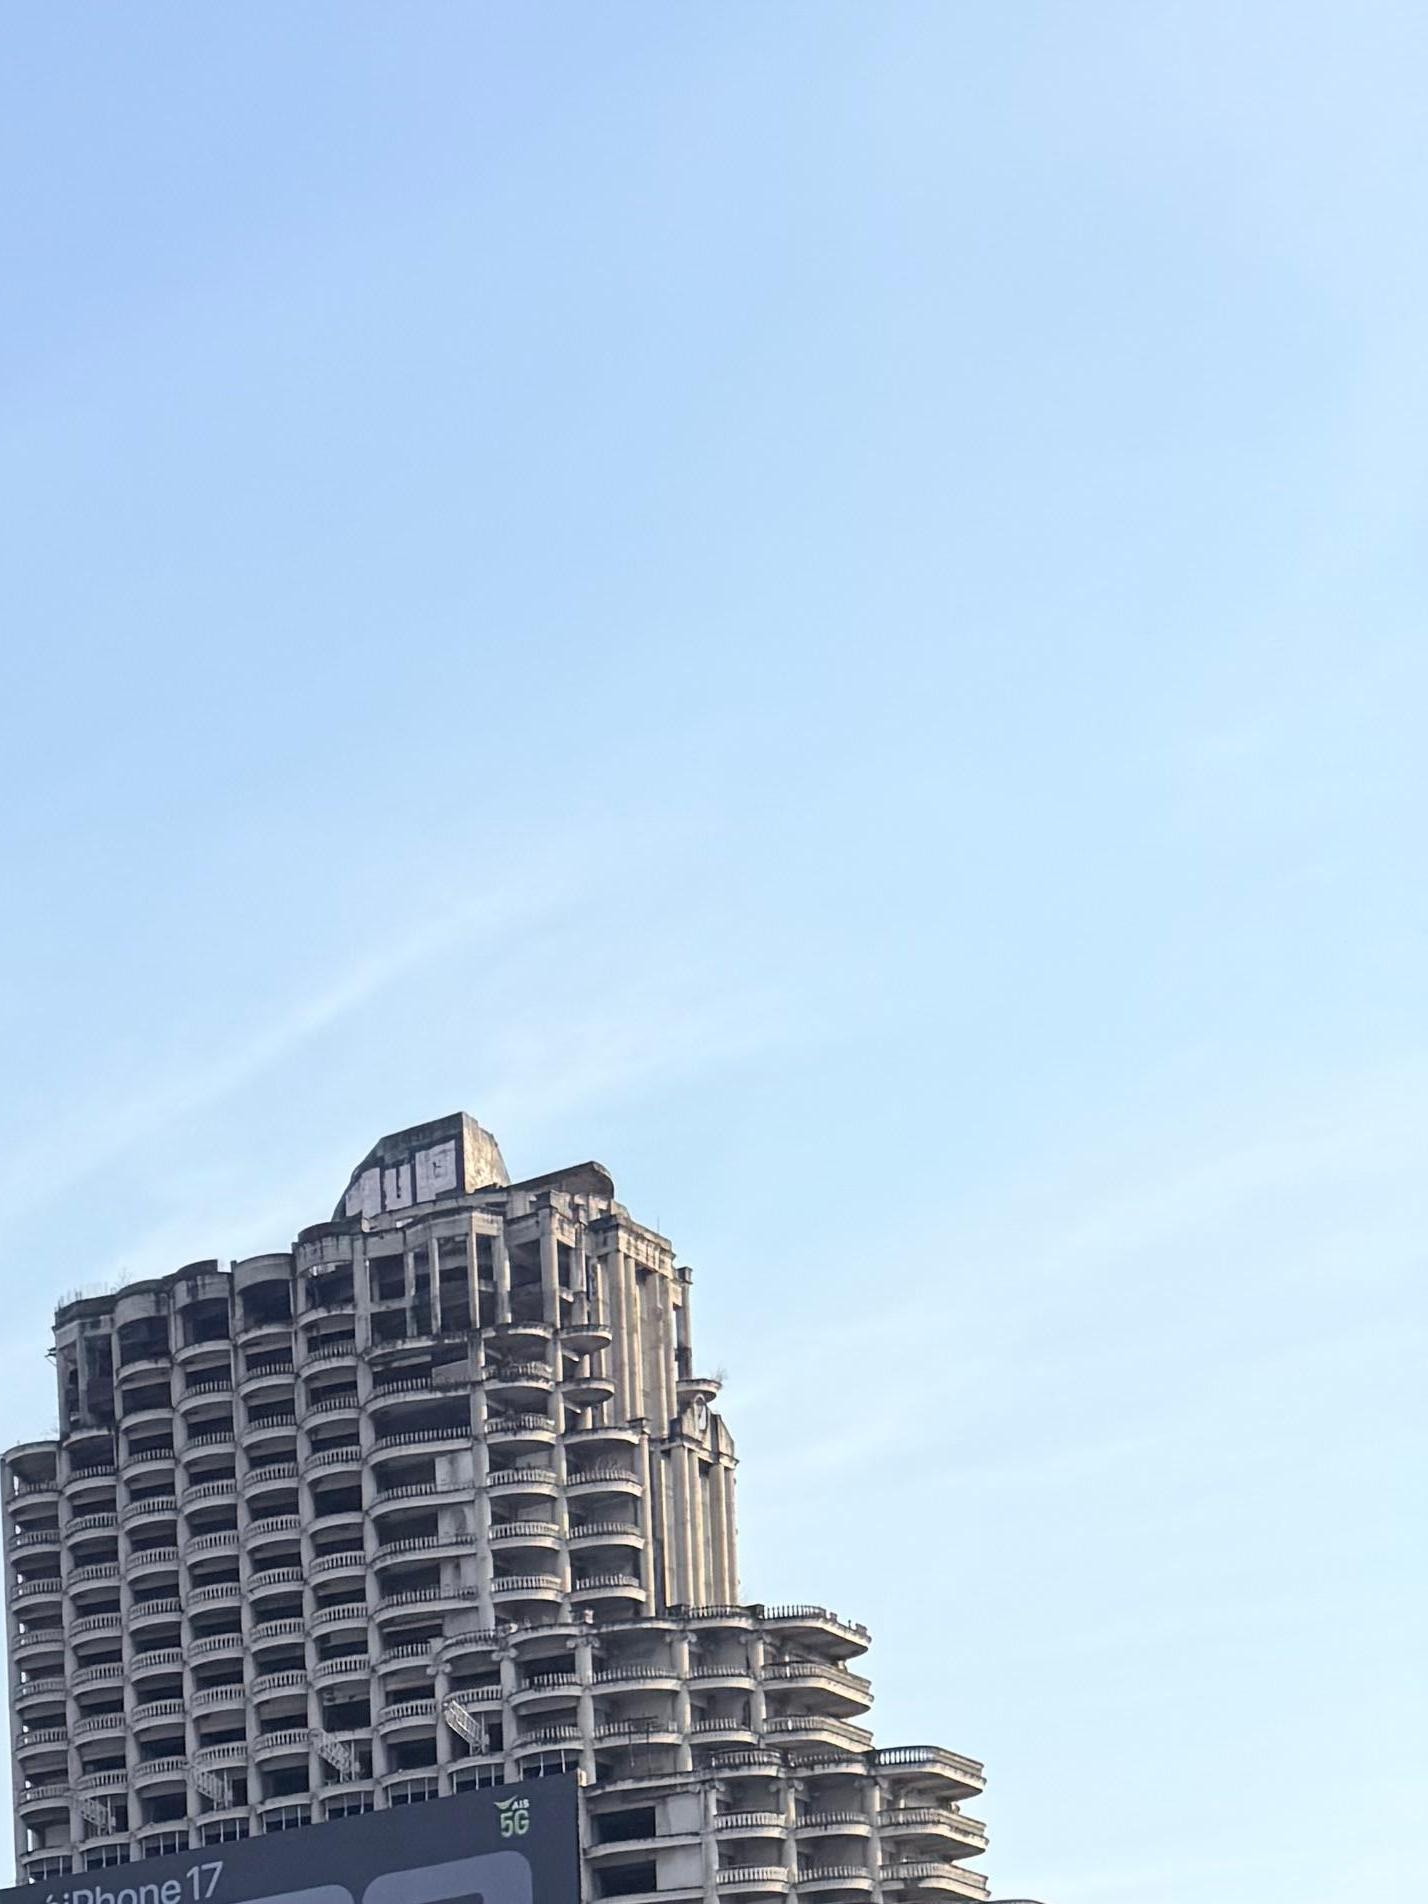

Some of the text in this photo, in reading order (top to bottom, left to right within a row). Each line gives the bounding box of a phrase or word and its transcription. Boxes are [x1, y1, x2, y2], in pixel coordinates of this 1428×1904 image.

[511, 1798, 530, 1810] AIS
[500, 1809, 530, 1838] 5G
[185, 1860, 225, 1902] 17
